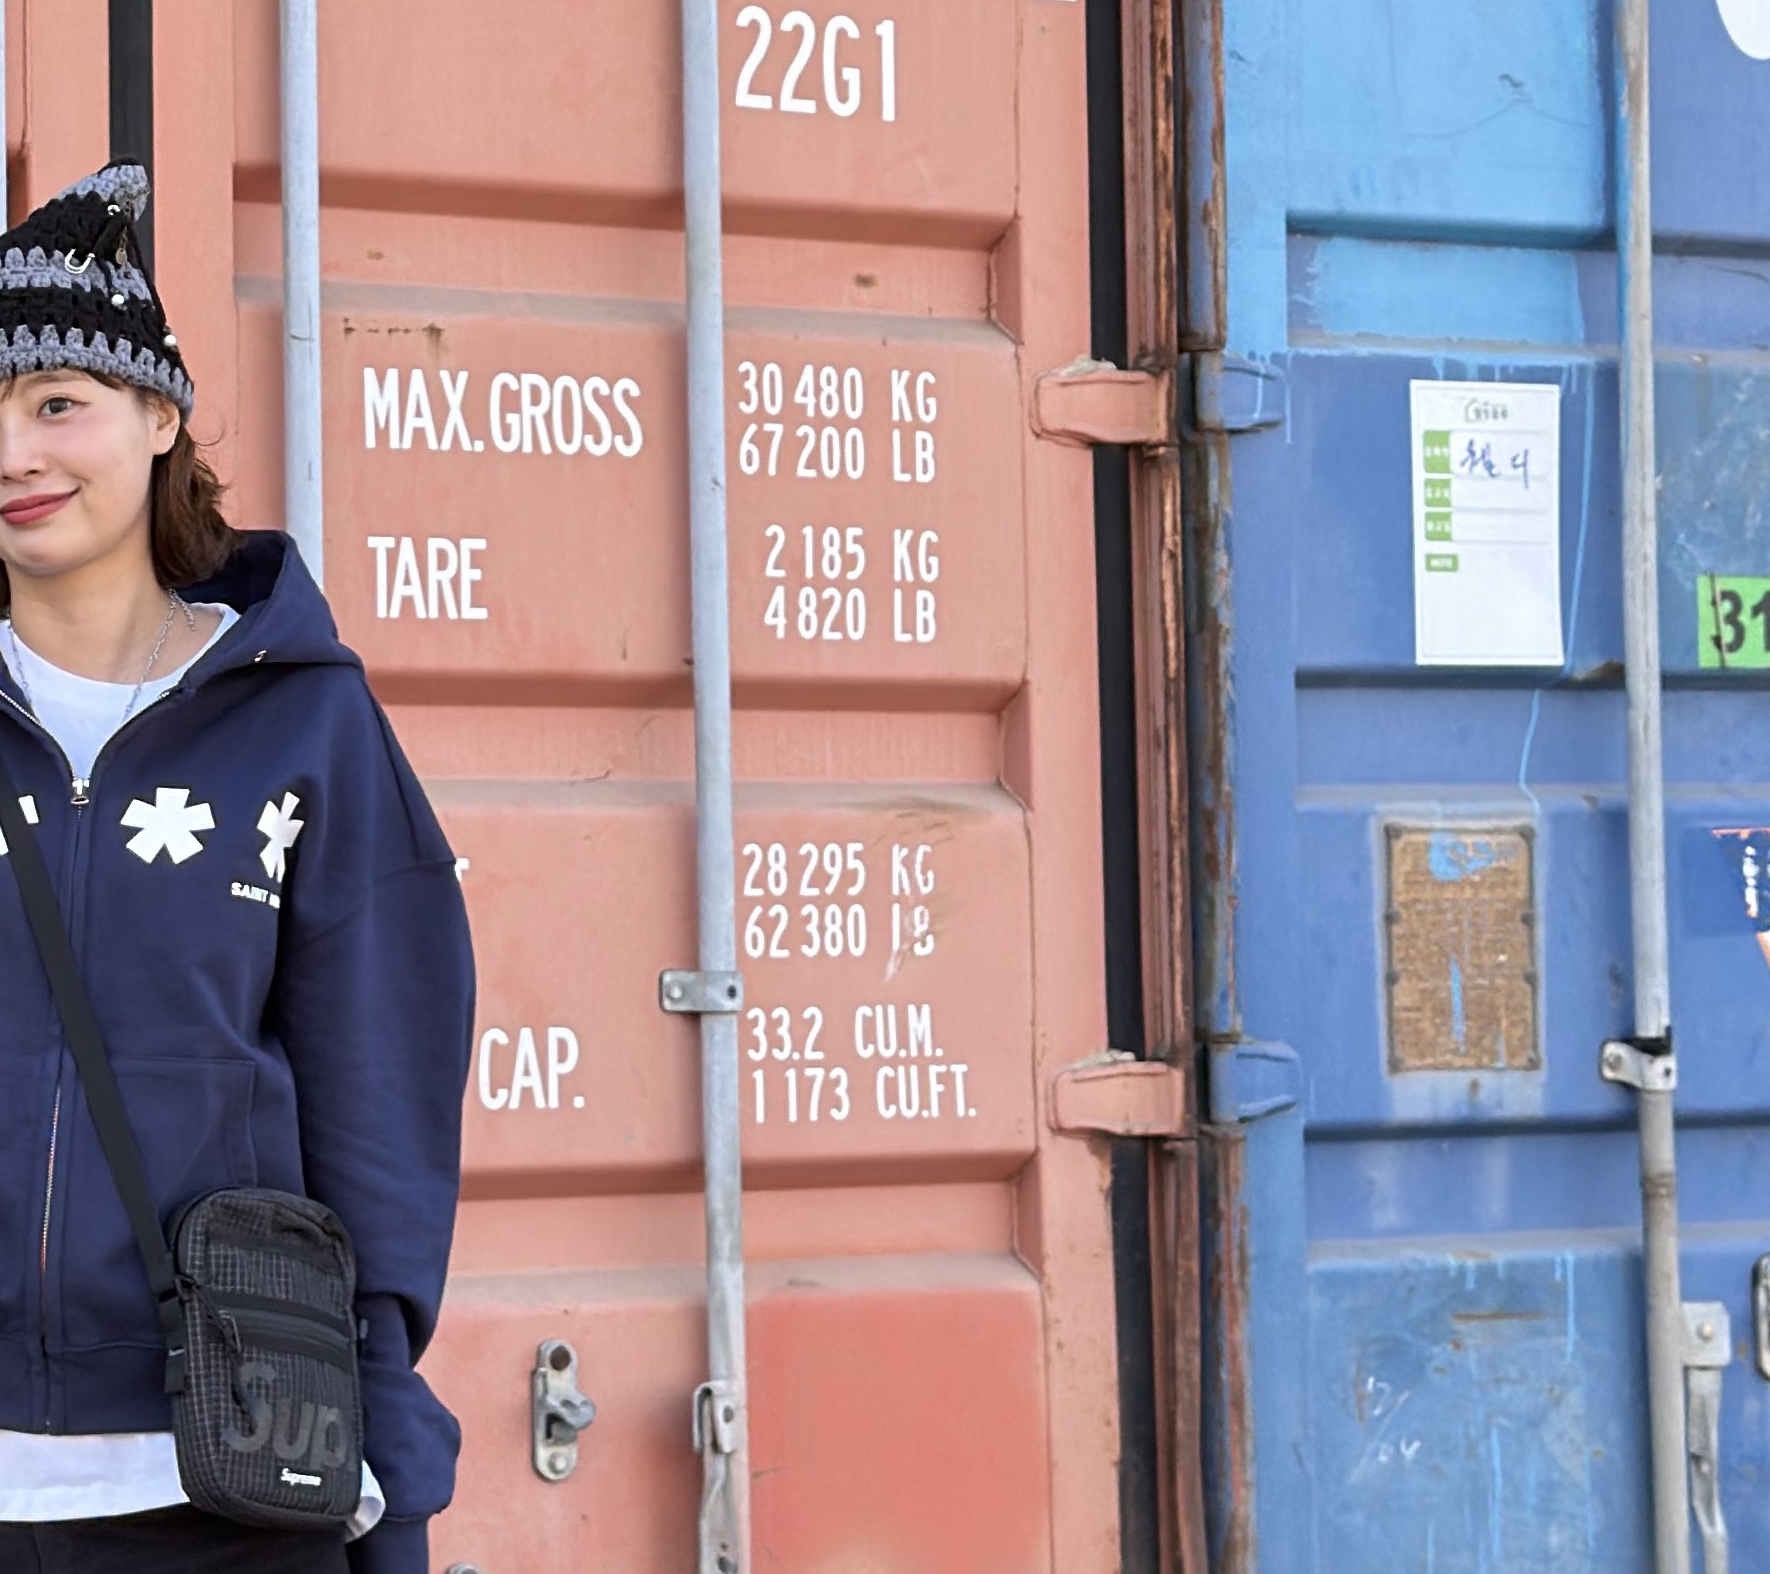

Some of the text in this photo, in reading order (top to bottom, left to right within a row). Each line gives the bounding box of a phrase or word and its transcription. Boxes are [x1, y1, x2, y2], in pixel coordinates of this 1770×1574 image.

[736, 6, 895, 121] 22G1
[892, 370, 936, 423] KG
[893, 429, 934, 482] LB
[368, 537, 488, 619] TARE
[894, 529, 938, 582] KG
[894, 589, 936, 642] LB
[479, 1004, 943, 1110] CAP. 33.2 CU.M.
[877, 1064, 976, 1118] CU.FT.
